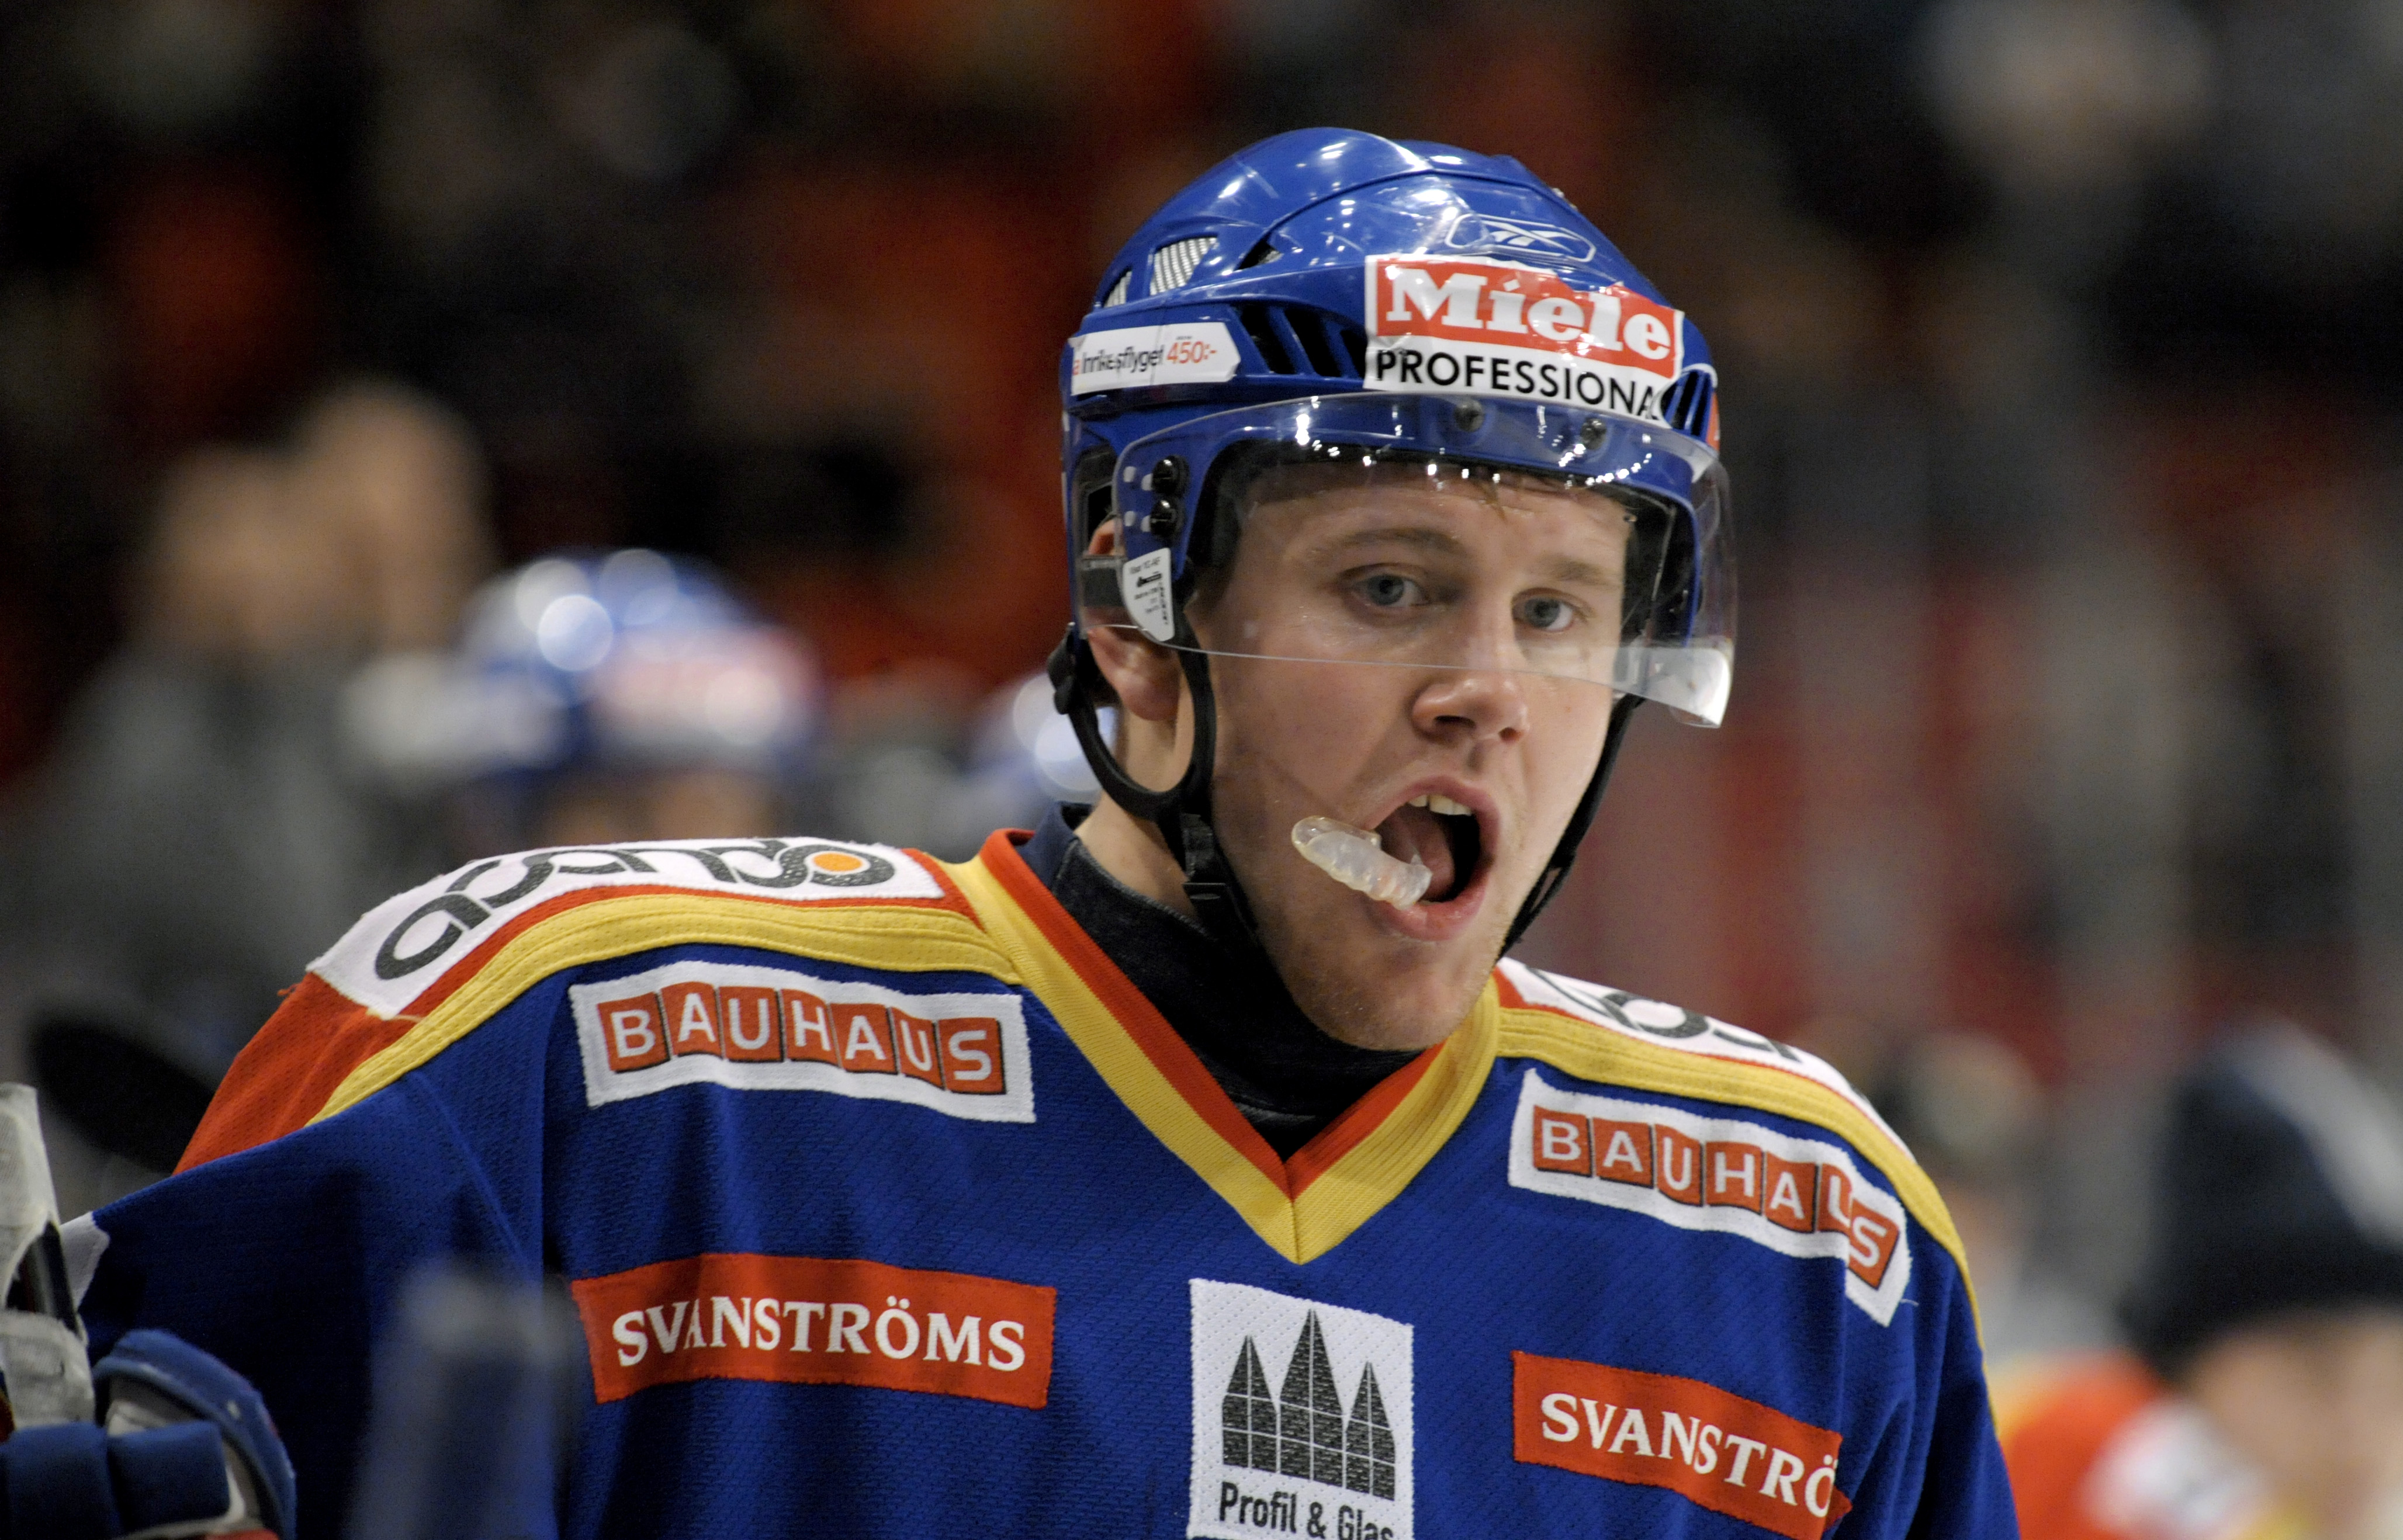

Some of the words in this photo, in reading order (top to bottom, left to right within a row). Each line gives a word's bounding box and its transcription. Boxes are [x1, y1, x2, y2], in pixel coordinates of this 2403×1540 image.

[1166, 341, 1217, 364] 450:-
[1386, 268, 1671, 360] Miele
[611, 991, 990, 1081] BAUHAUS
[611, 1295, 1025, 1372] SVANSTRÖMS
[1219, 1481, 1296, 1534] Profil
[1307, 1502, 1326, 1539] &
